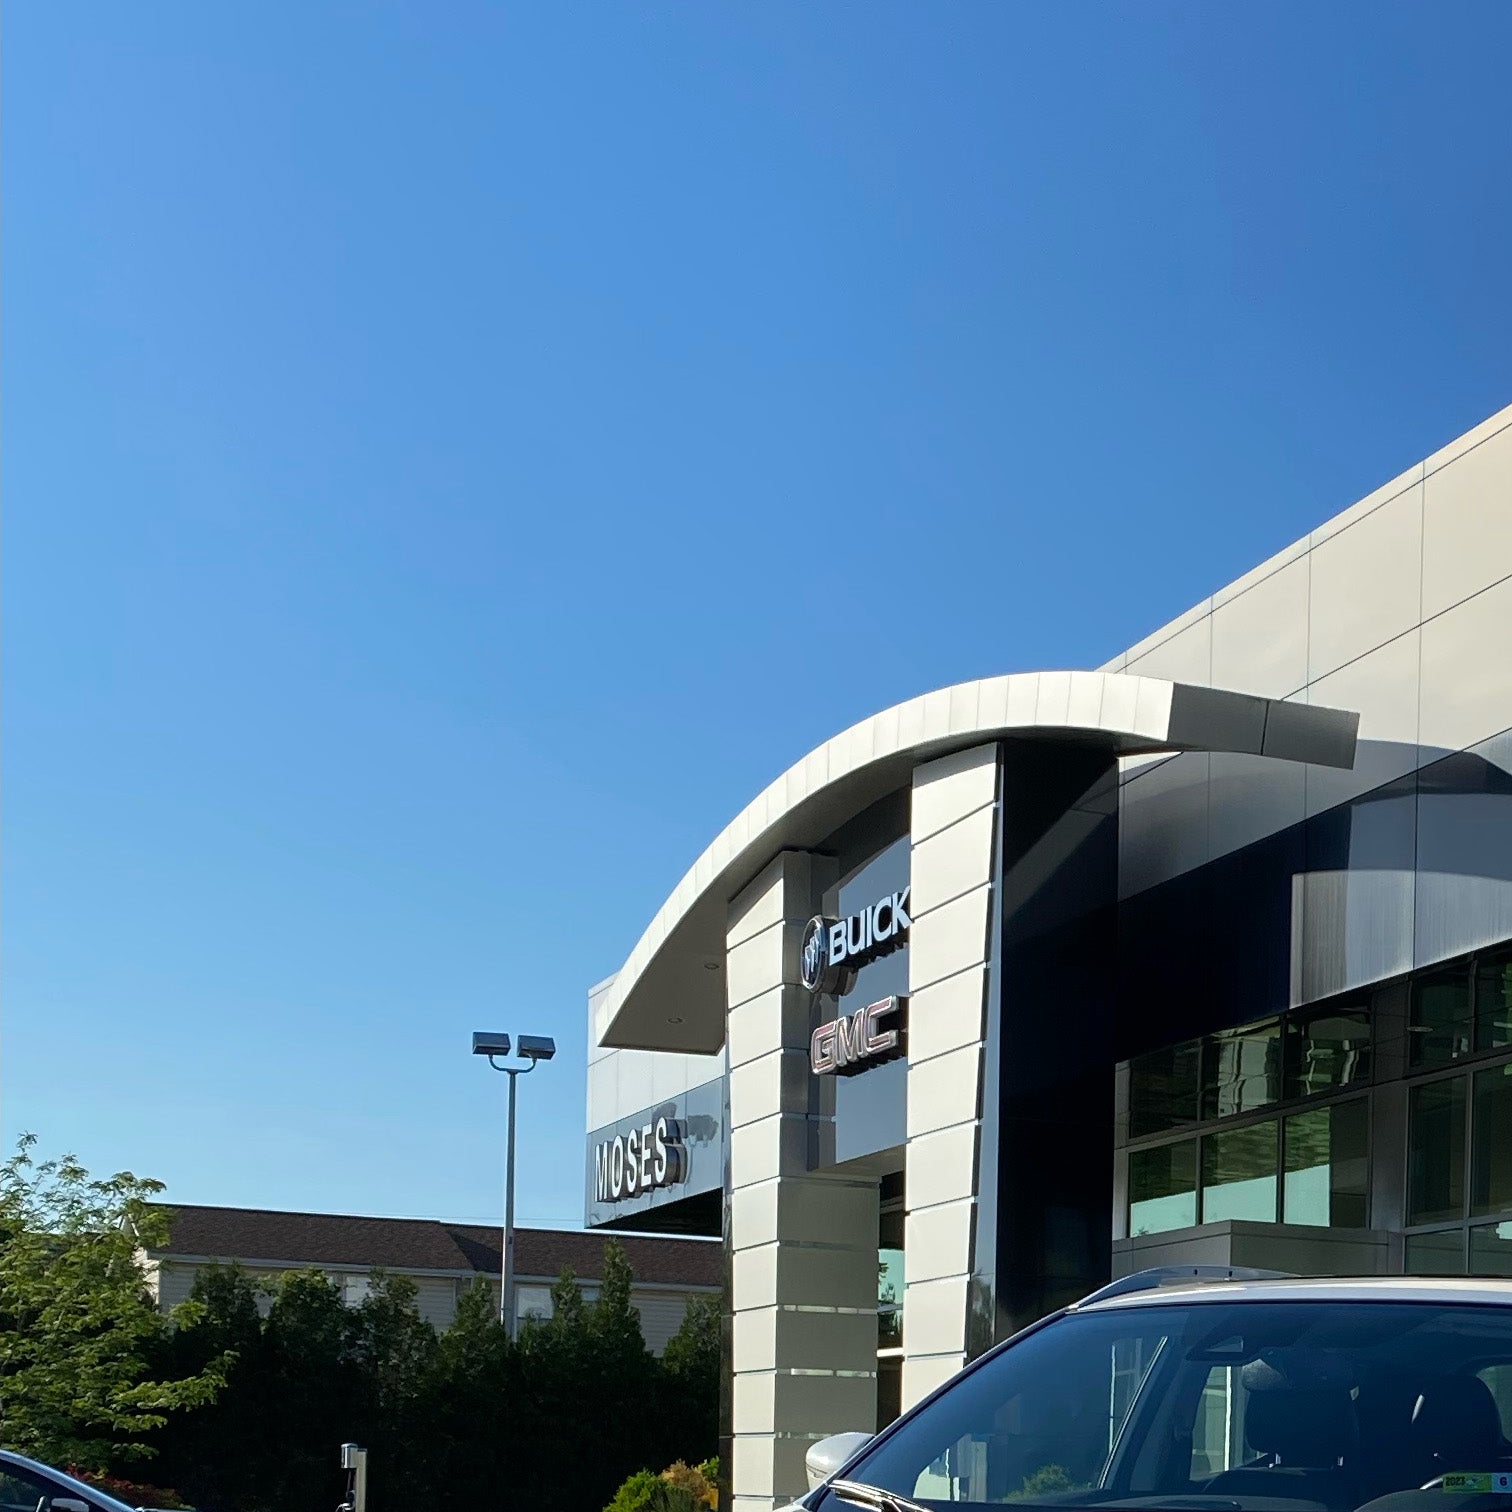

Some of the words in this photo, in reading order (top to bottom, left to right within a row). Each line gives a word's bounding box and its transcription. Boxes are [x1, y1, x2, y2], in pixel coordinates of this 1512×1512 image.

[829, 885, 913, 966] BUICK
[811, 995, 899, 1074] GMC
[594, 1117, 669, 1202] MOSES
